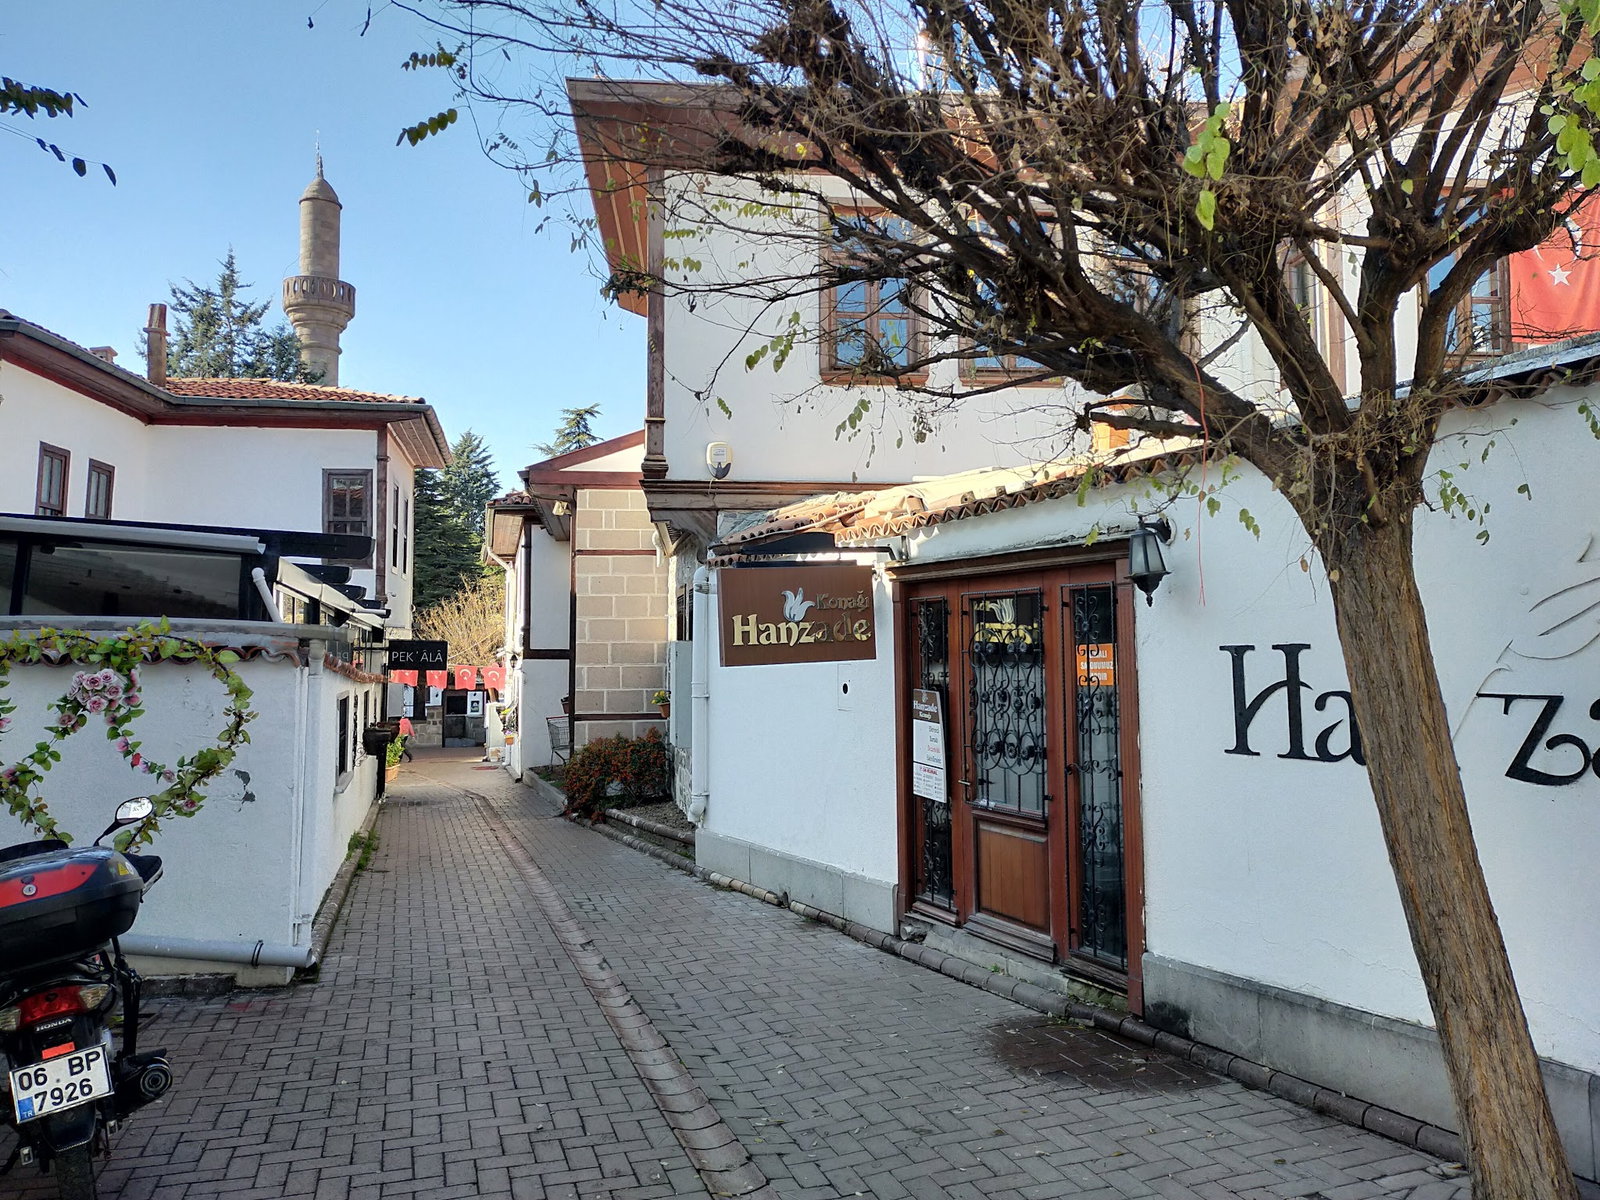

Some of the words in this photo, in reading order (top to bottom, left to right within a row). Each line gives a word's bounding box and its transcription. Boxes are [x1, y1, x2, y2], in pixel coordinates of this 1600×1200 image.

[816, 591, 870, 611] Konağı
[732, 612, 872, 648] Hanzade
[35, 1018, 73, 1032] HONDA
[18, 1067, 47, 1091] 06
[68, 1050, 101, 1076] BP
[34, 1078, 93, 1112] 7926
[23, 1110, 33, 1118] TR
